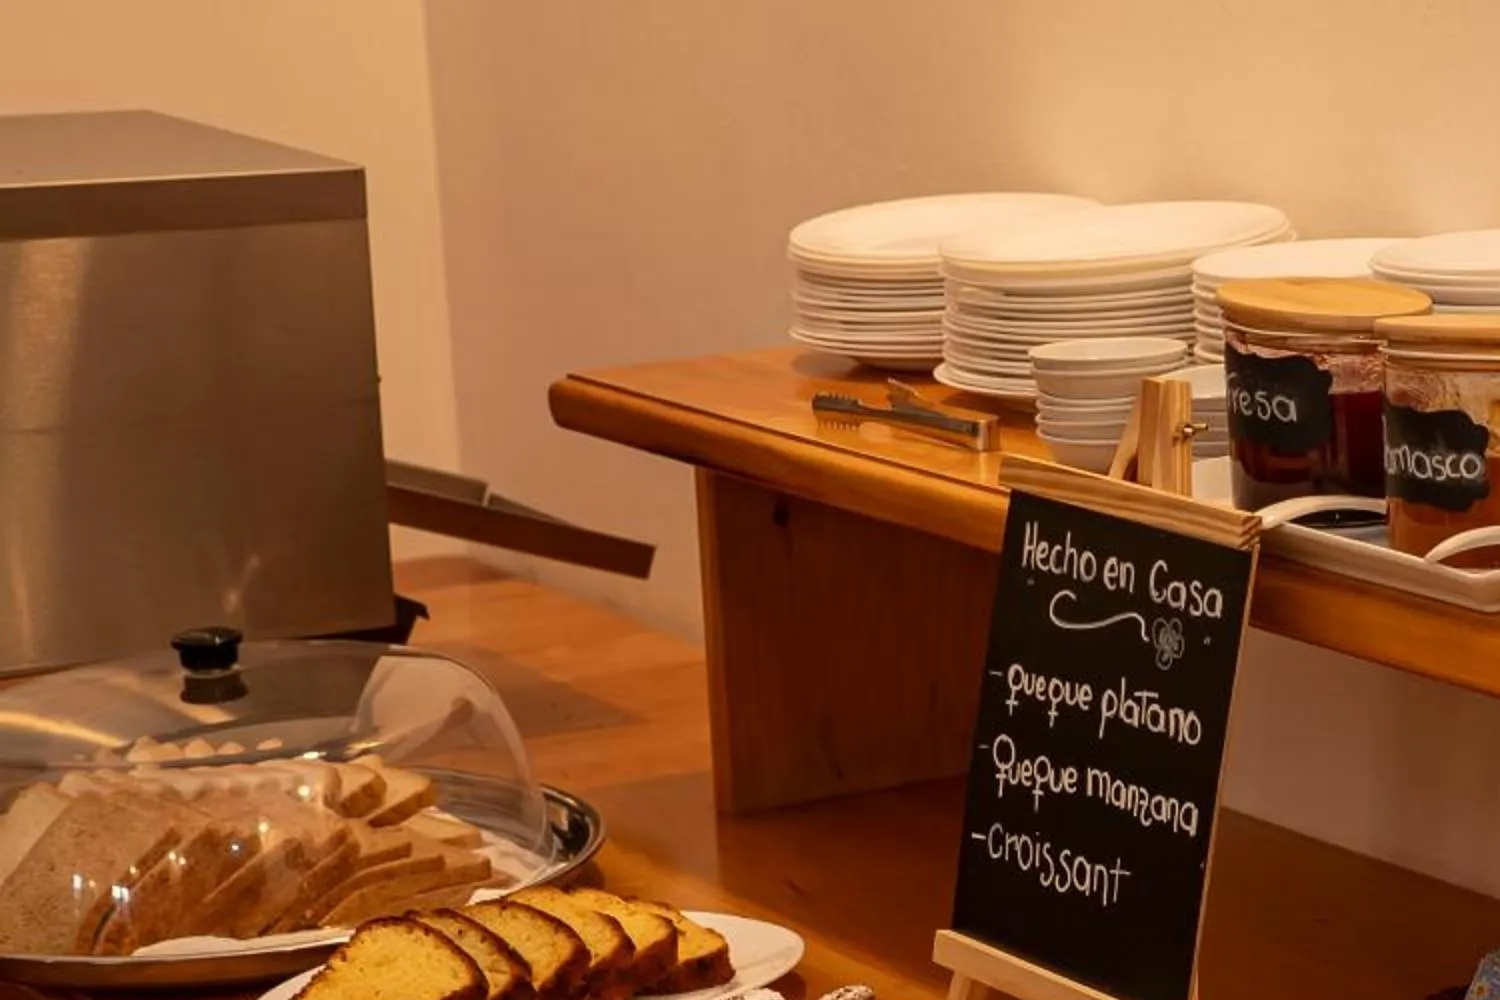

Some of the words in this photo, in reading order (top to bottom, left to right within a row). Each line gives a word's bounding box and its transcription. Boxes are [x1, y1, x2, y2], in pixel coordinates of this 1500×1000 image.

[1022, 521, 1097, 582] Hecho
[1103, 556, 1135, 593] en
[1150, 560, 1223, 619] Casa
[1087, 766, 1200, 838] manzana
